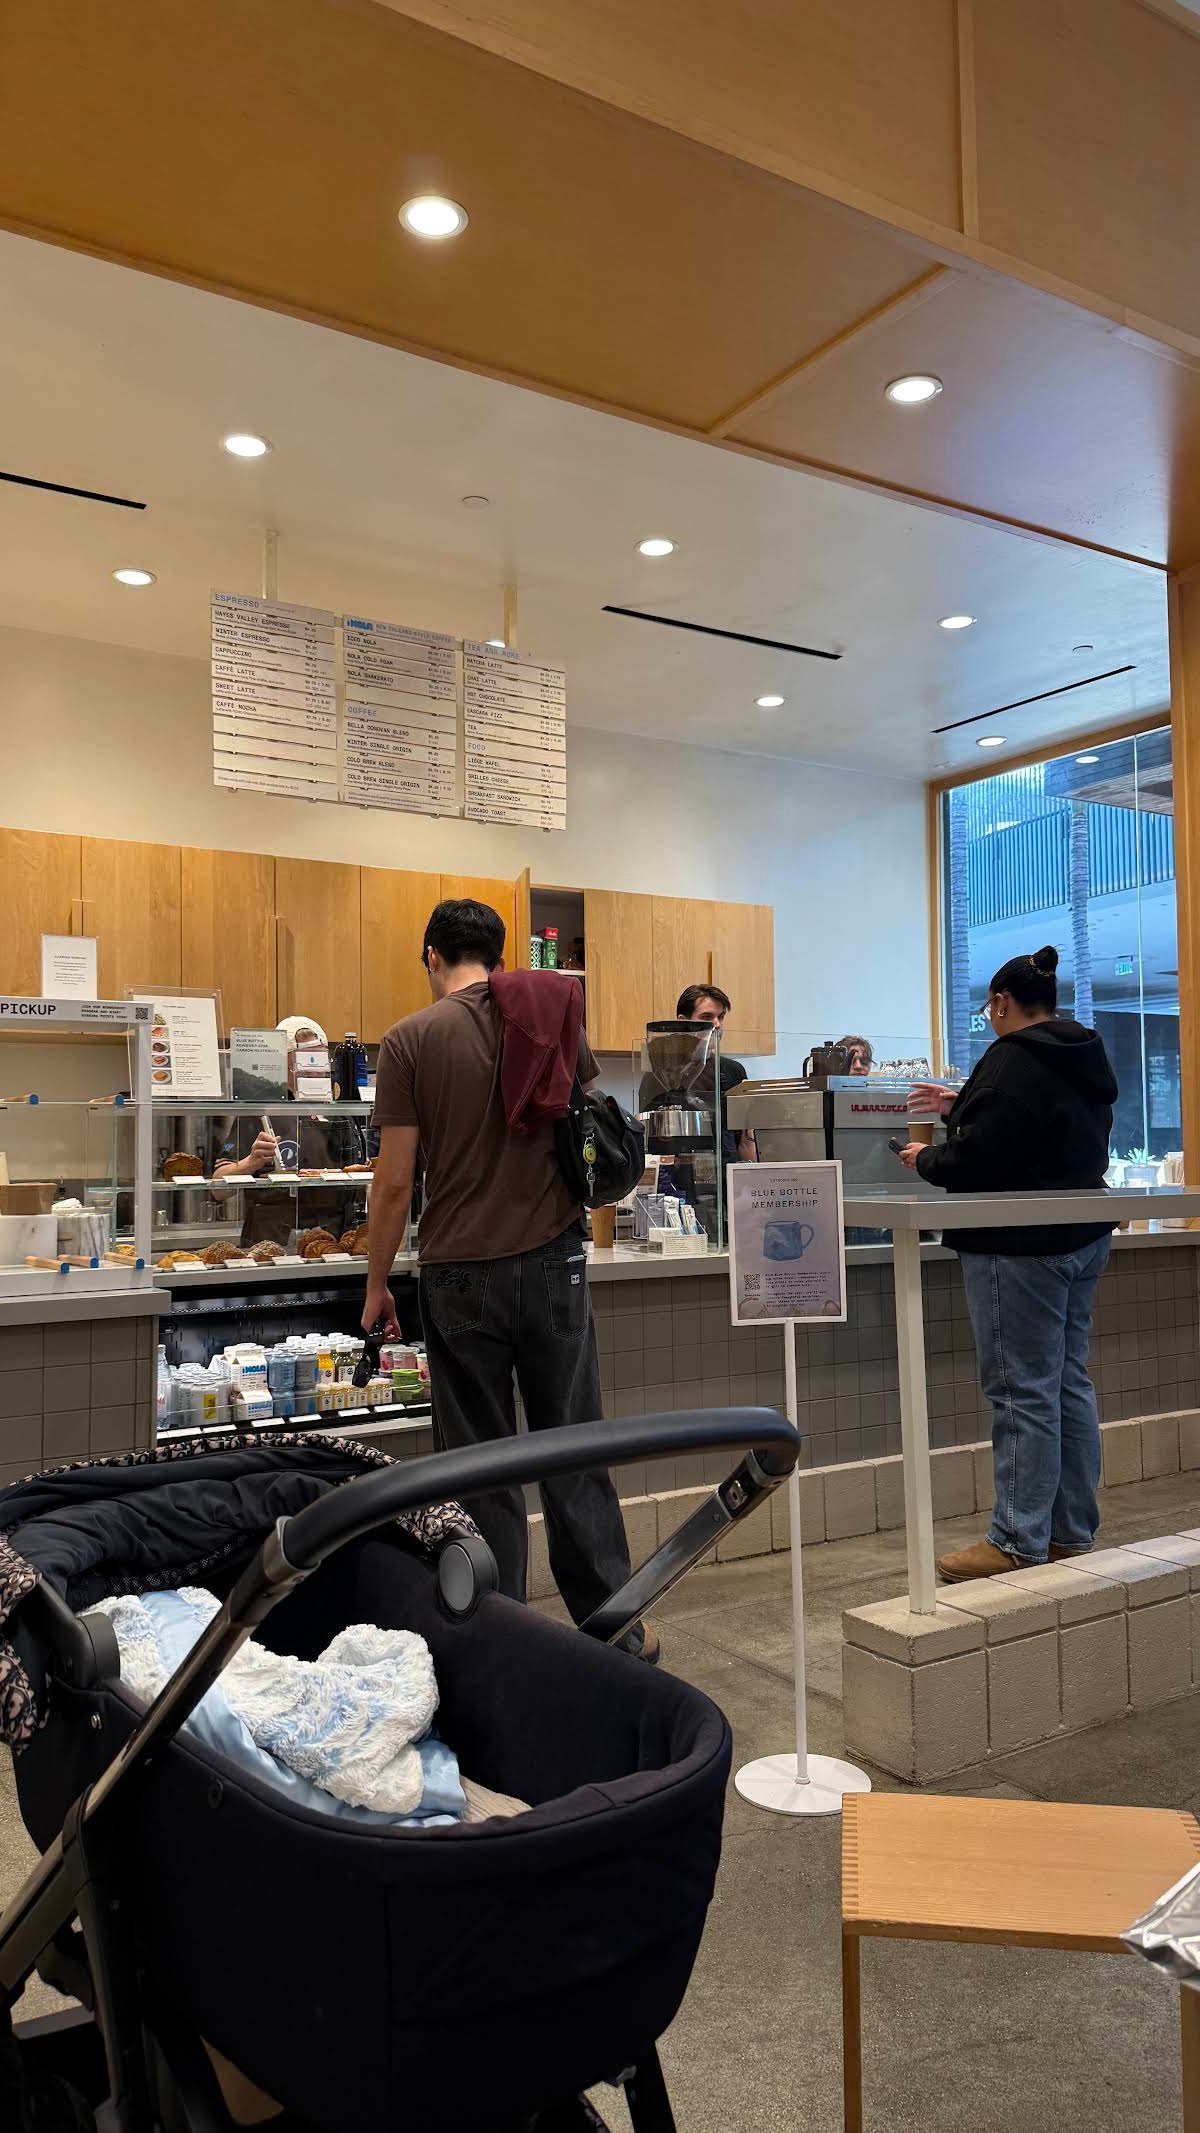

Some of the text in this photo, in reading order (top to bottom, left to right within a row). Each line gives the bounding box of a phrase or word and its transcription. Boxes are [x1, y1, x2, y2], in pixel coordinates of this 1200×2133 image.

[215, 594, 260, 608] ESPRESSO
[215, 610, 234, 619] HAYES
[236, 614, 258, 623] VALLEY
[261, 619, 290, 628] ESPRESSO
[215, 627, 271, 642] WINTER ESPRESSO
[215, 646, 252, 657] CAPPUCCINO
[468, 643, 520, 659] TEA AND MORE
[467, 658, 485, 667] MATCHA
[237, 668, 256, 676] LATTE
[215, 682, 256, 694] SWEET LATTE
[479, 693, 505, 702] CHOCOLATE
[238, 704, 257, 712] MOCHA
[347, 706, 377, 716] COFFEE
[467, 708, 488, 716] CASCARA
[347, 722, 364, 730] BELLA
[367, 725, 390, 733] DONOVAN
[347, 739, 412, 753] WINTER SINGLE ORIGIN
[467, 742, 486, 750] FOOD
[467, 790, 495, 798] BREAKFAST
[0, 1003, 56, 1016] PICKUP
[751, 1187, 819, 1197] BLUE BOTTLE
[751, 1199, 819, 1209] MEMBERSHIP
